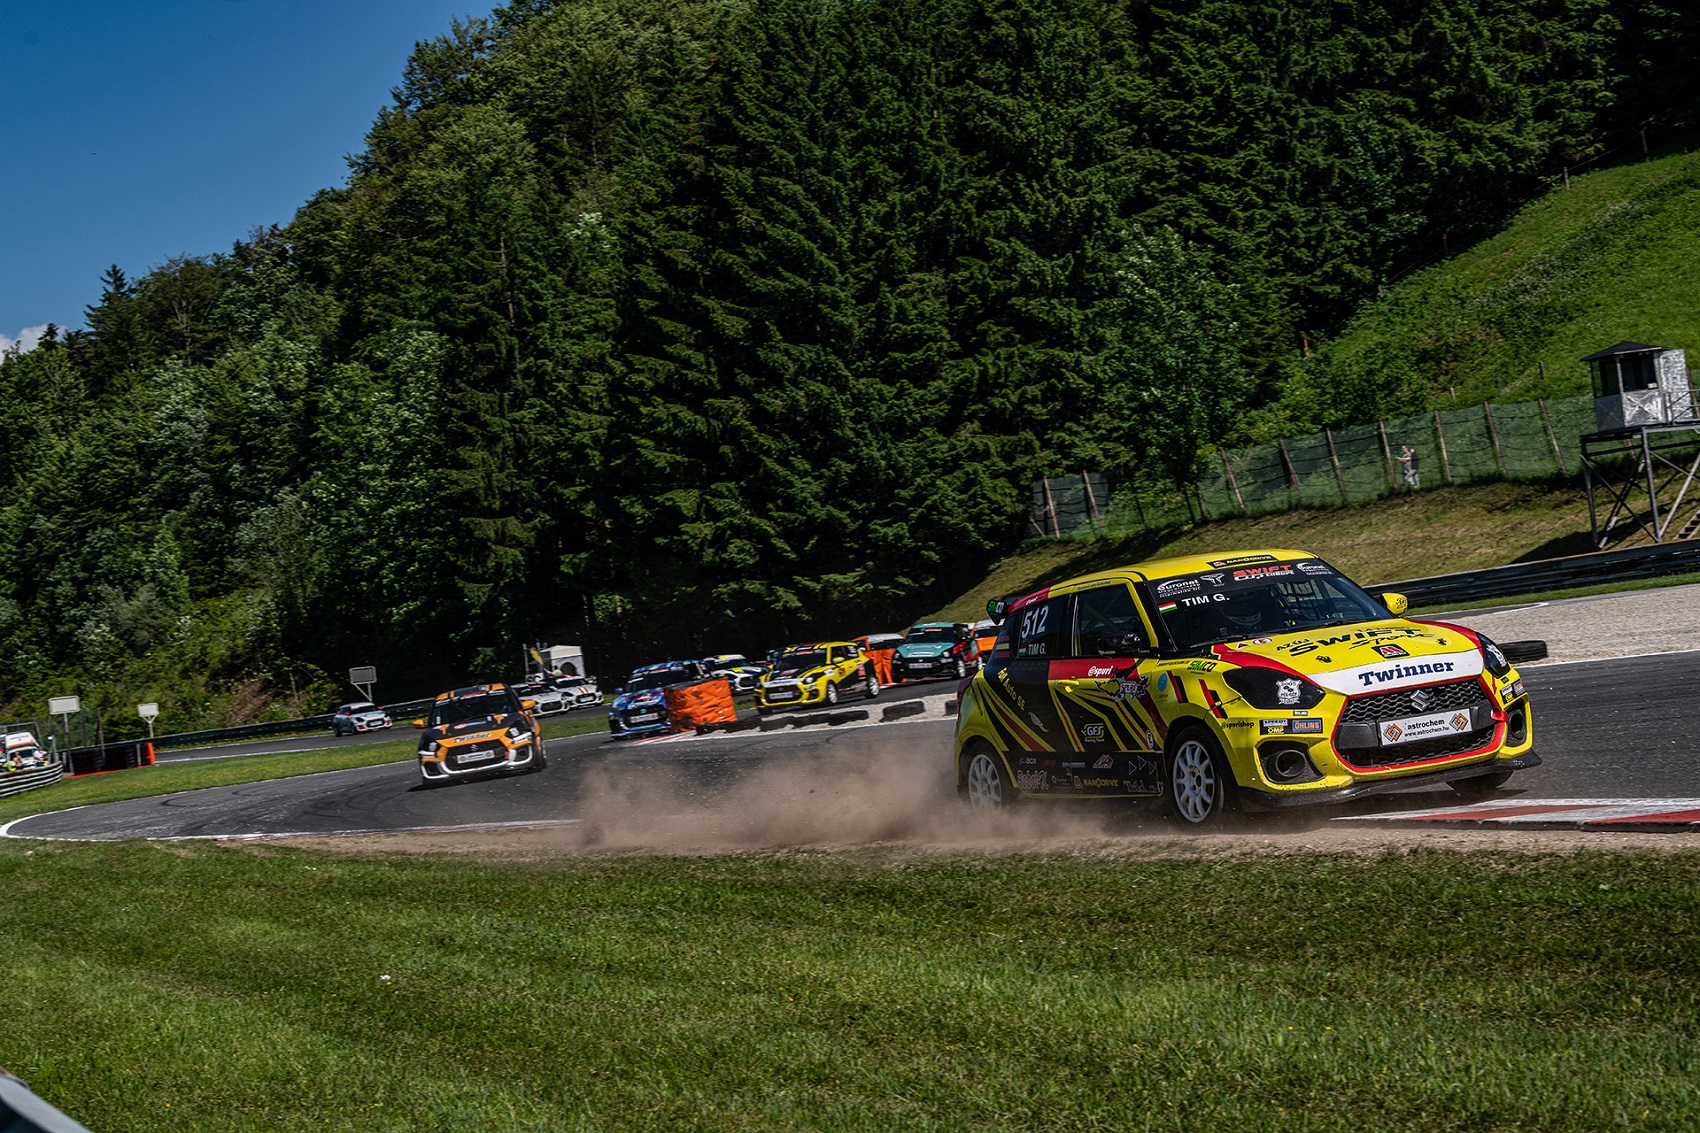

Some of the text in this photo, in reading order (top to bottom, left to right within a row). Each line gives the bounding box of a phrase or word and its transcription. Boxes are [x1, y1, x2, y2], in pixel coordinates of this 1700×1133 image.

[1232, 564, 1292, 577] SWIFT
[1234, 573, 1263, 582] CUP
[1265, 569, 1295, 577] EUROPE
[1181, 593, 1230, 607] TIM G.
[1021, 605, 1049, 639] 512
[1028, 642, 1047, 656] TIM G.
[1289, 629, 1421, 656] SWIFT
[1187, 660, 1217, 673] SIMCO
[1358, 661, 1454, 686] Twinner
[1294, 721, 1320, 729] ÖHLINS
[1407, 719, 1445, 730] astrochem
[1404, 726, 1450, 737] www.astrochem.hu
[1083, 777, 1119, 788] NANODRIVE
